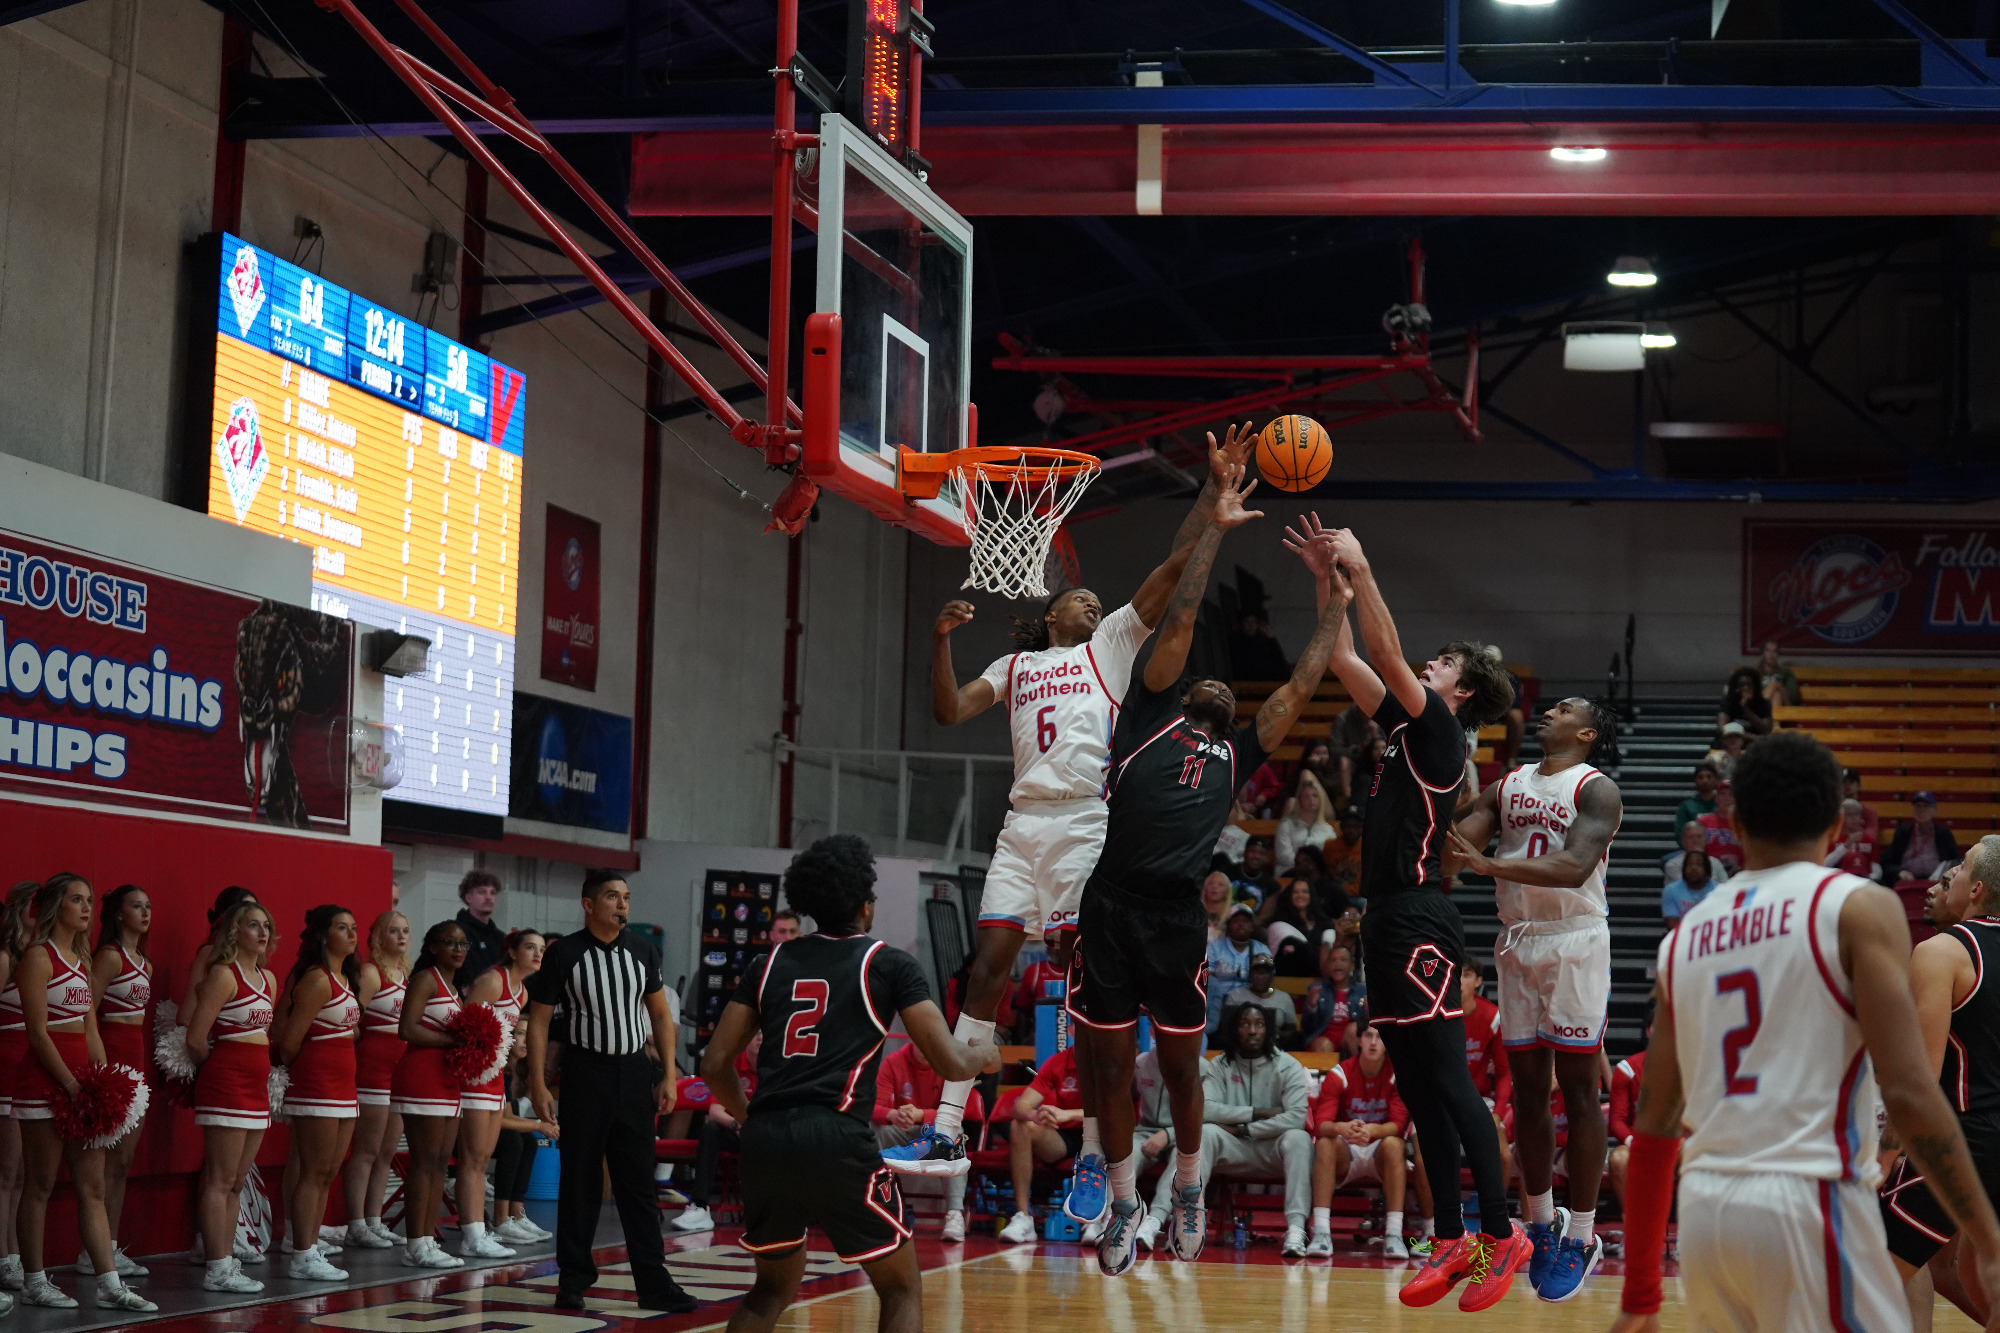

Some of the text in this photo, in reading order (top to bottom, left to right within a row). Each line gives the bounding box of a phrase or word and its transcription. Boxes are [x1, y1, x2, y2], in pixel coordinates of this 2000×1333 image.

[300, 277, 323, 329] 64
[274, 336, 292, 354] TEAM
[292, 344, 304, 359] FLS
[364, 308, 405, 366] 12:14
[361, 360, 402, 398] PERIOD 2
[447, 344, 468, 394] 58
[280, 465, 288, 491] 2
[0, 614, 223, 731] occasins
[1017, 661, 1083, 691] Florida
[1014, 680, 1091, 712] Southern
[1036, 704, 1058, 754] 6
[1178, 754, 1206, 789] 11
[1527, 832, 1548, 858] 0
[1687, 898, 1796, 962] TREMBLE
[782, 978, 830, 1058] 2
[1554, 1024, 1589, 1038] MOCS
[1716, 967, 1762, 1098] 2
